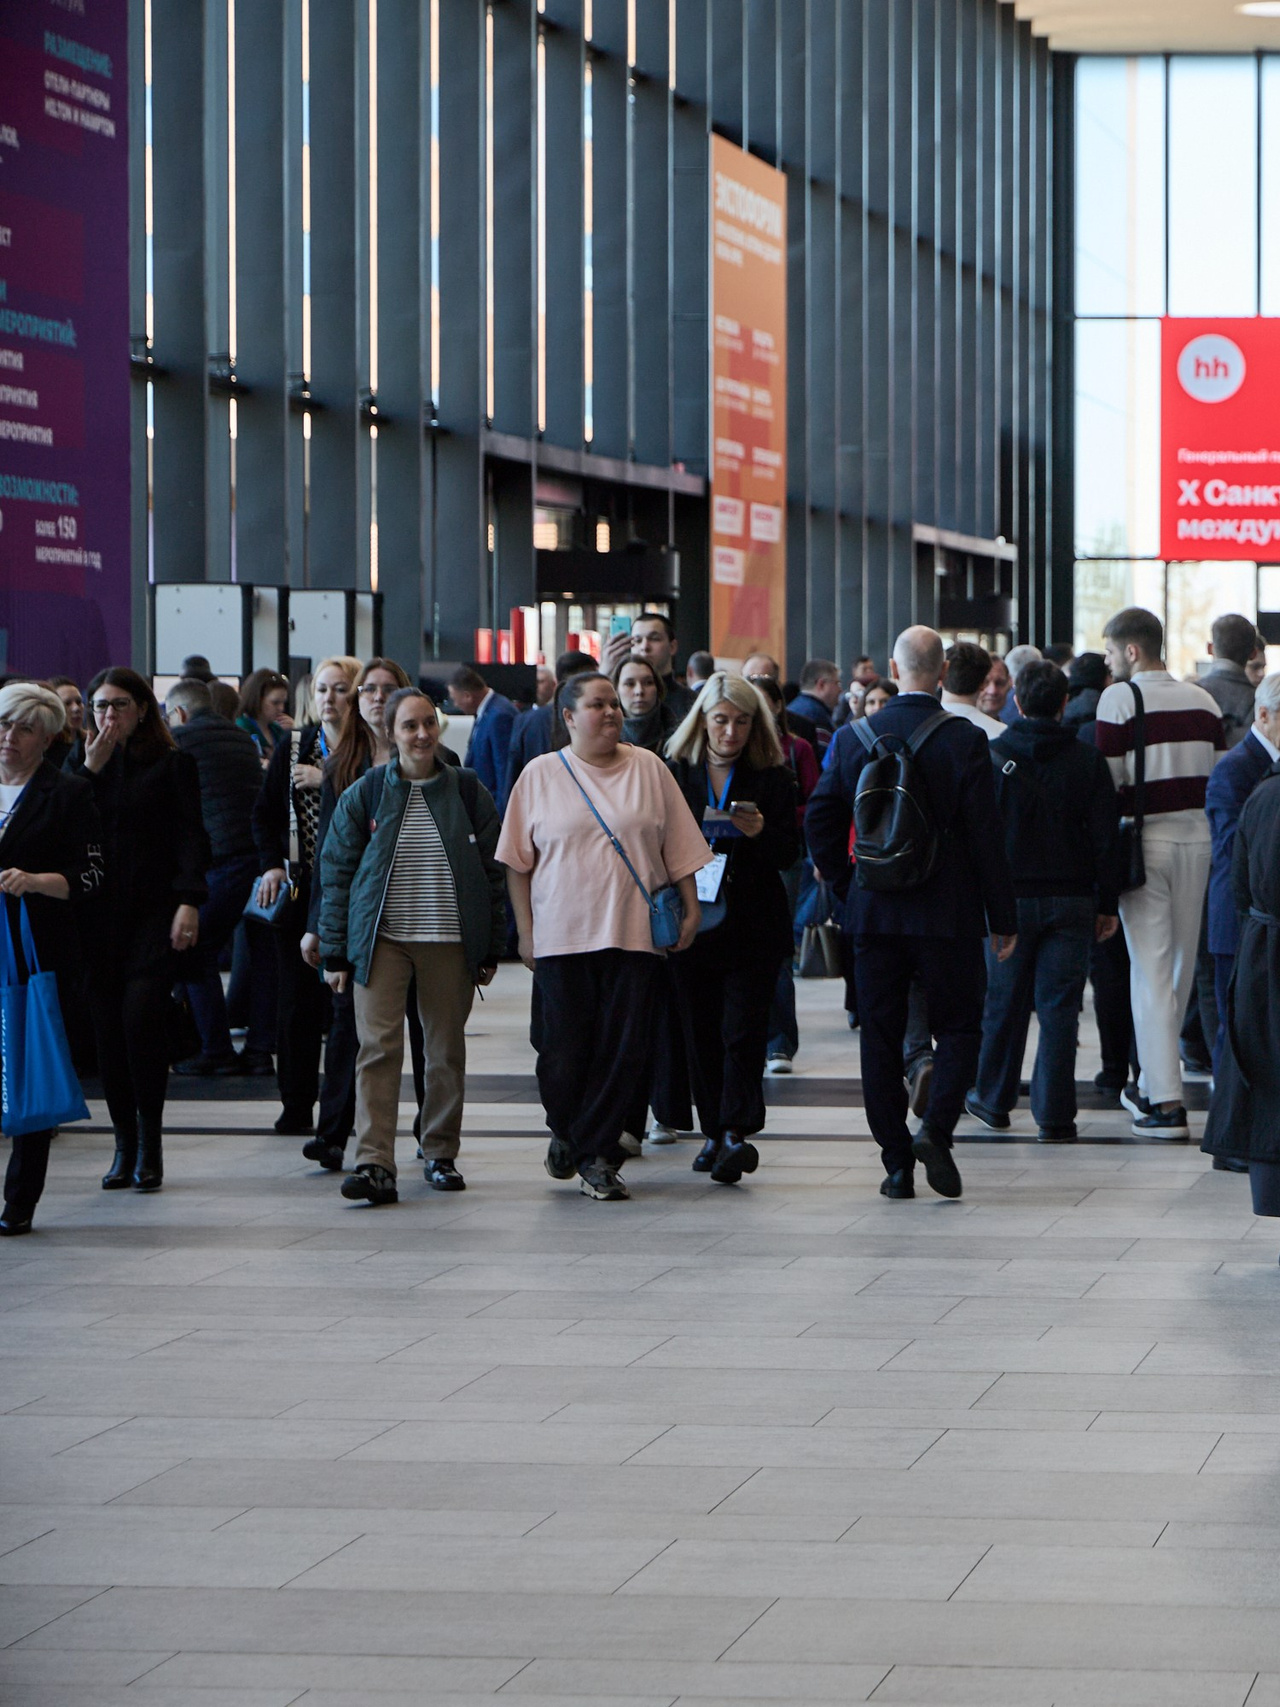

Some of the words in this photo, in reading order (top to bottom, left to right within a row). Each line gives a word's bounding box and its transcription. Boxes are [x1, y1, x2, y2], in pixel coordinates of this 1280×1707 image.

[1193, 355, 1229, 380] hh
[1178, 448, 1268, 466] Генеральный
[57, 514, 77, 542] 150
